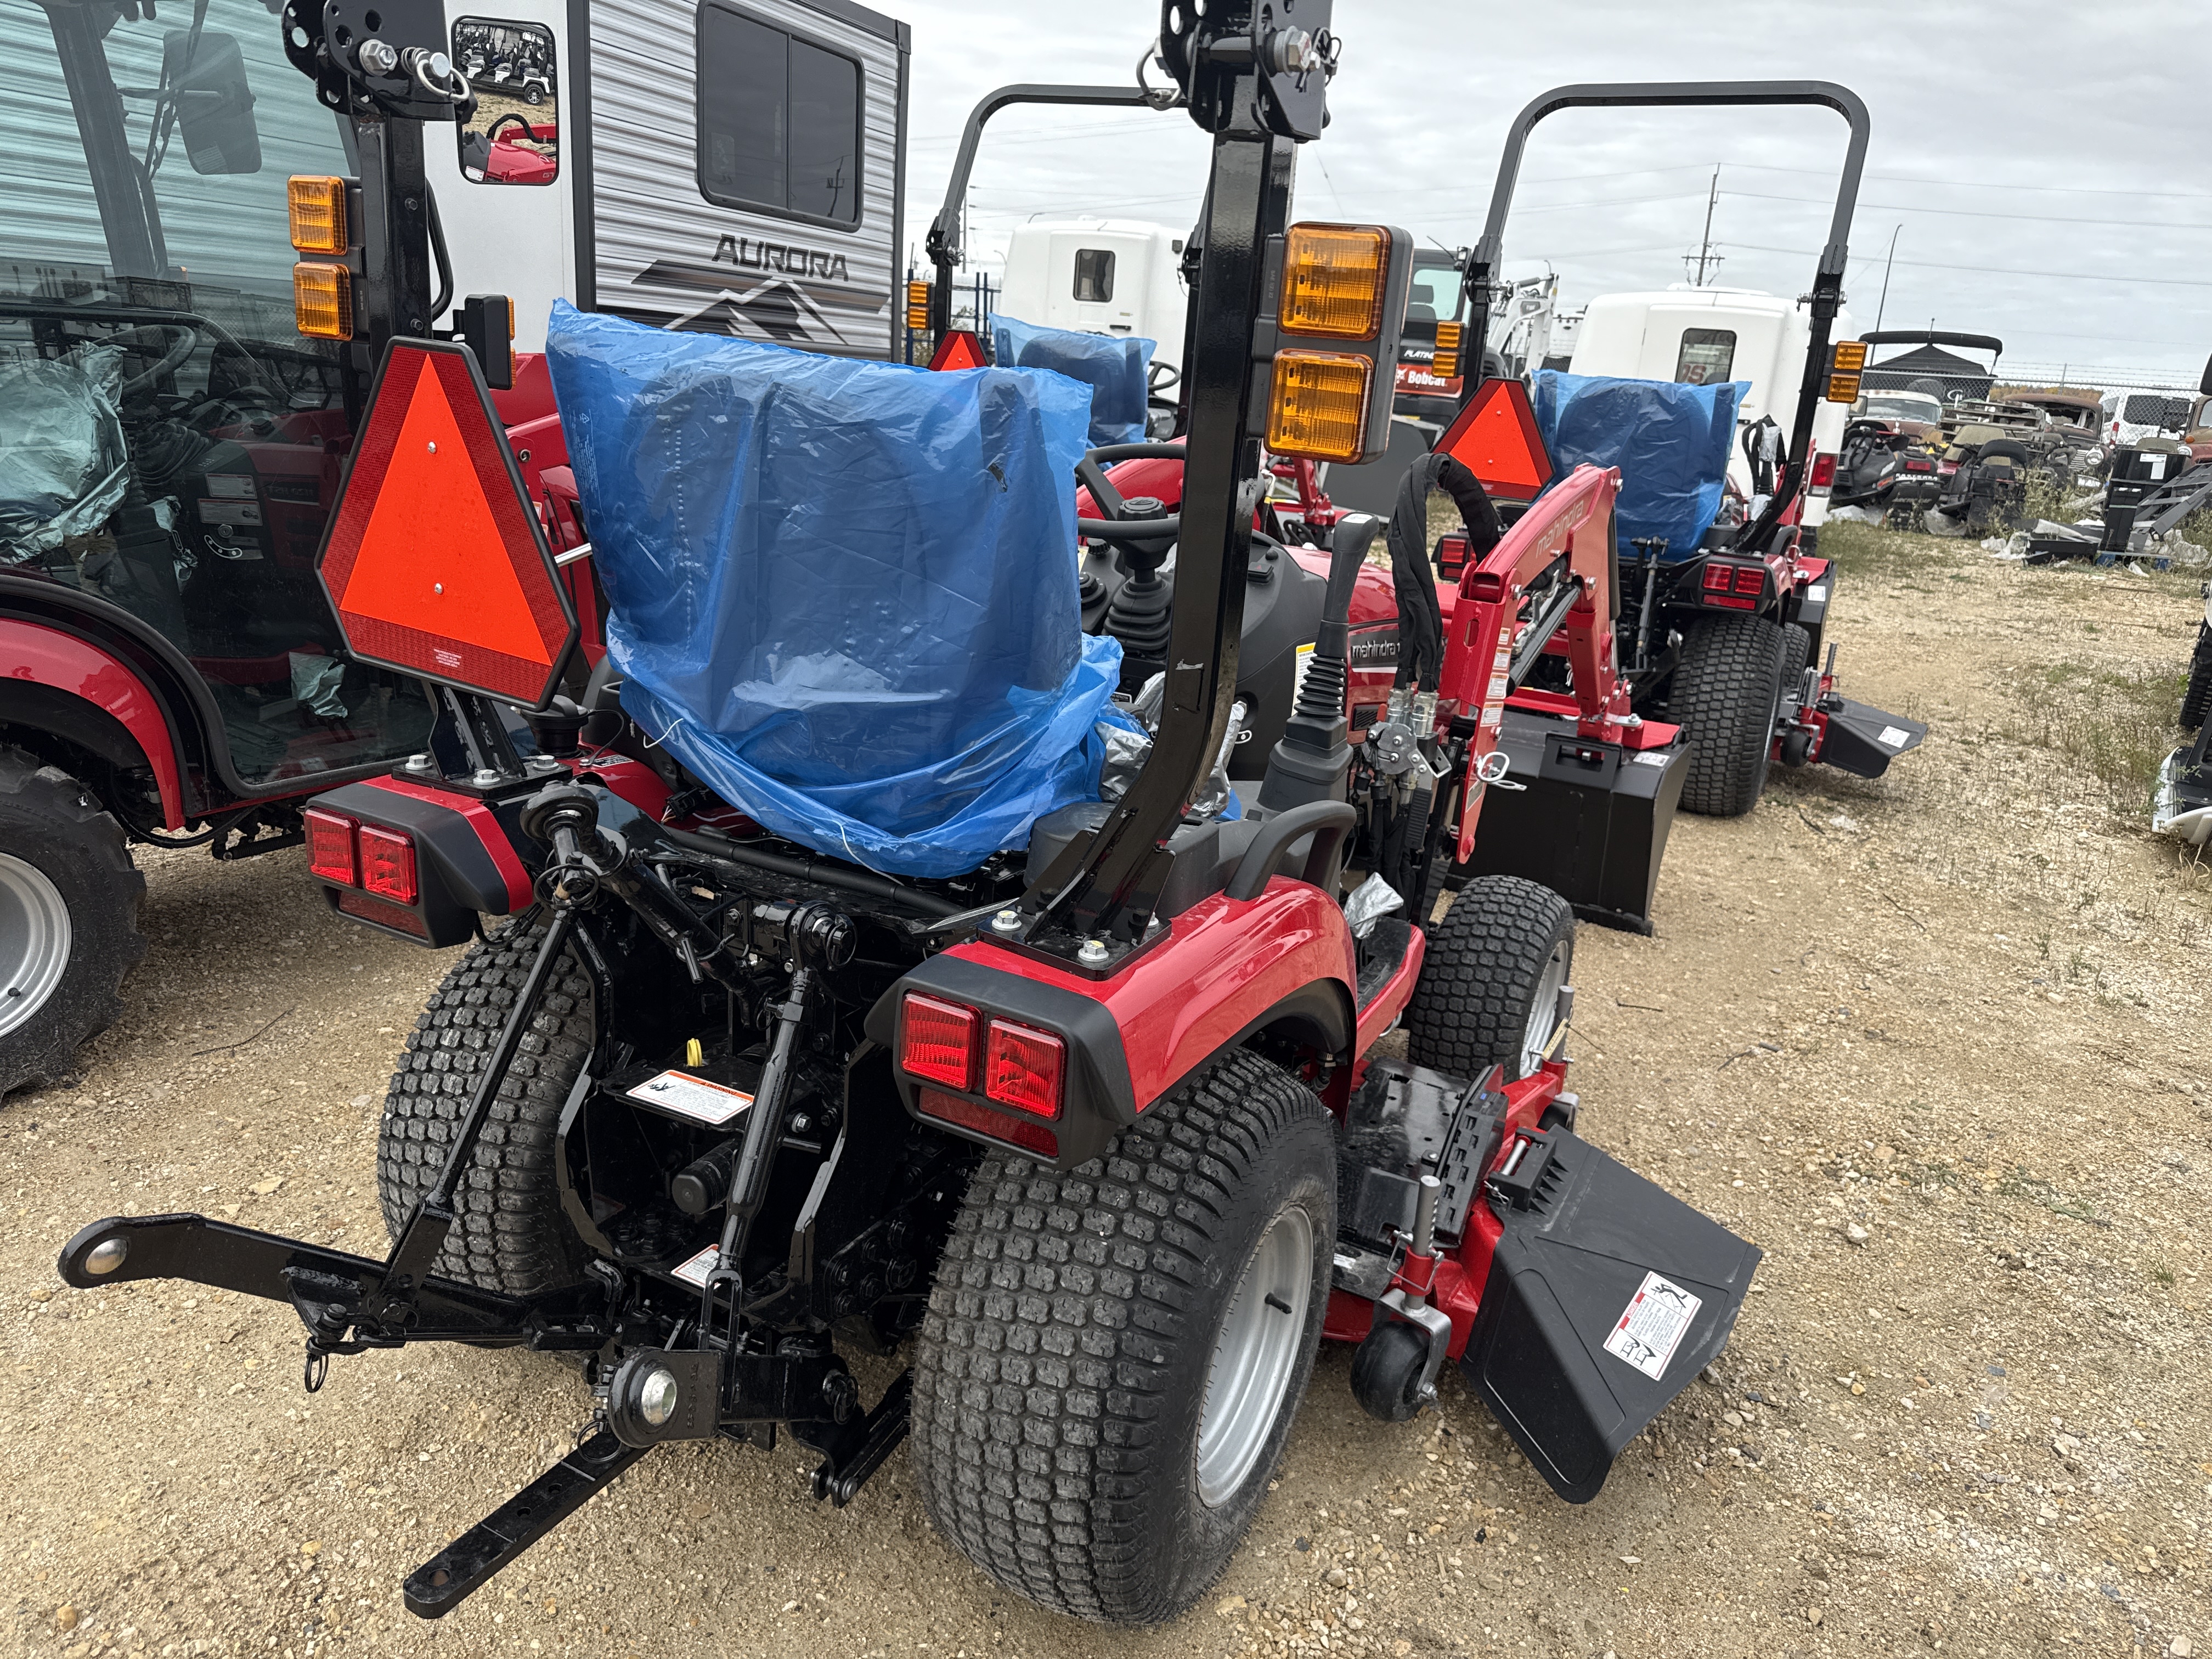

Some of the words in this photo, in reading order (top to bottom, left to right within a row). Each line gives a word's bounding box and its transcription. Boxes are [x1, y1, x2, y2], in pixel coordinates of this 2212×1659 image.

[712, 233, 849, 281] AURORA
[1404, 349, 1434, 359] PLATIN
[1407, 370, 1446, 387] Bobcat
[1536, 500, 1584, 558] mahindra
[1351, 640, 1396, 658] mahindra
[707, 1082, 737, 1095] WARNING
[1628, 1301, 1639, 1316] DANGER
